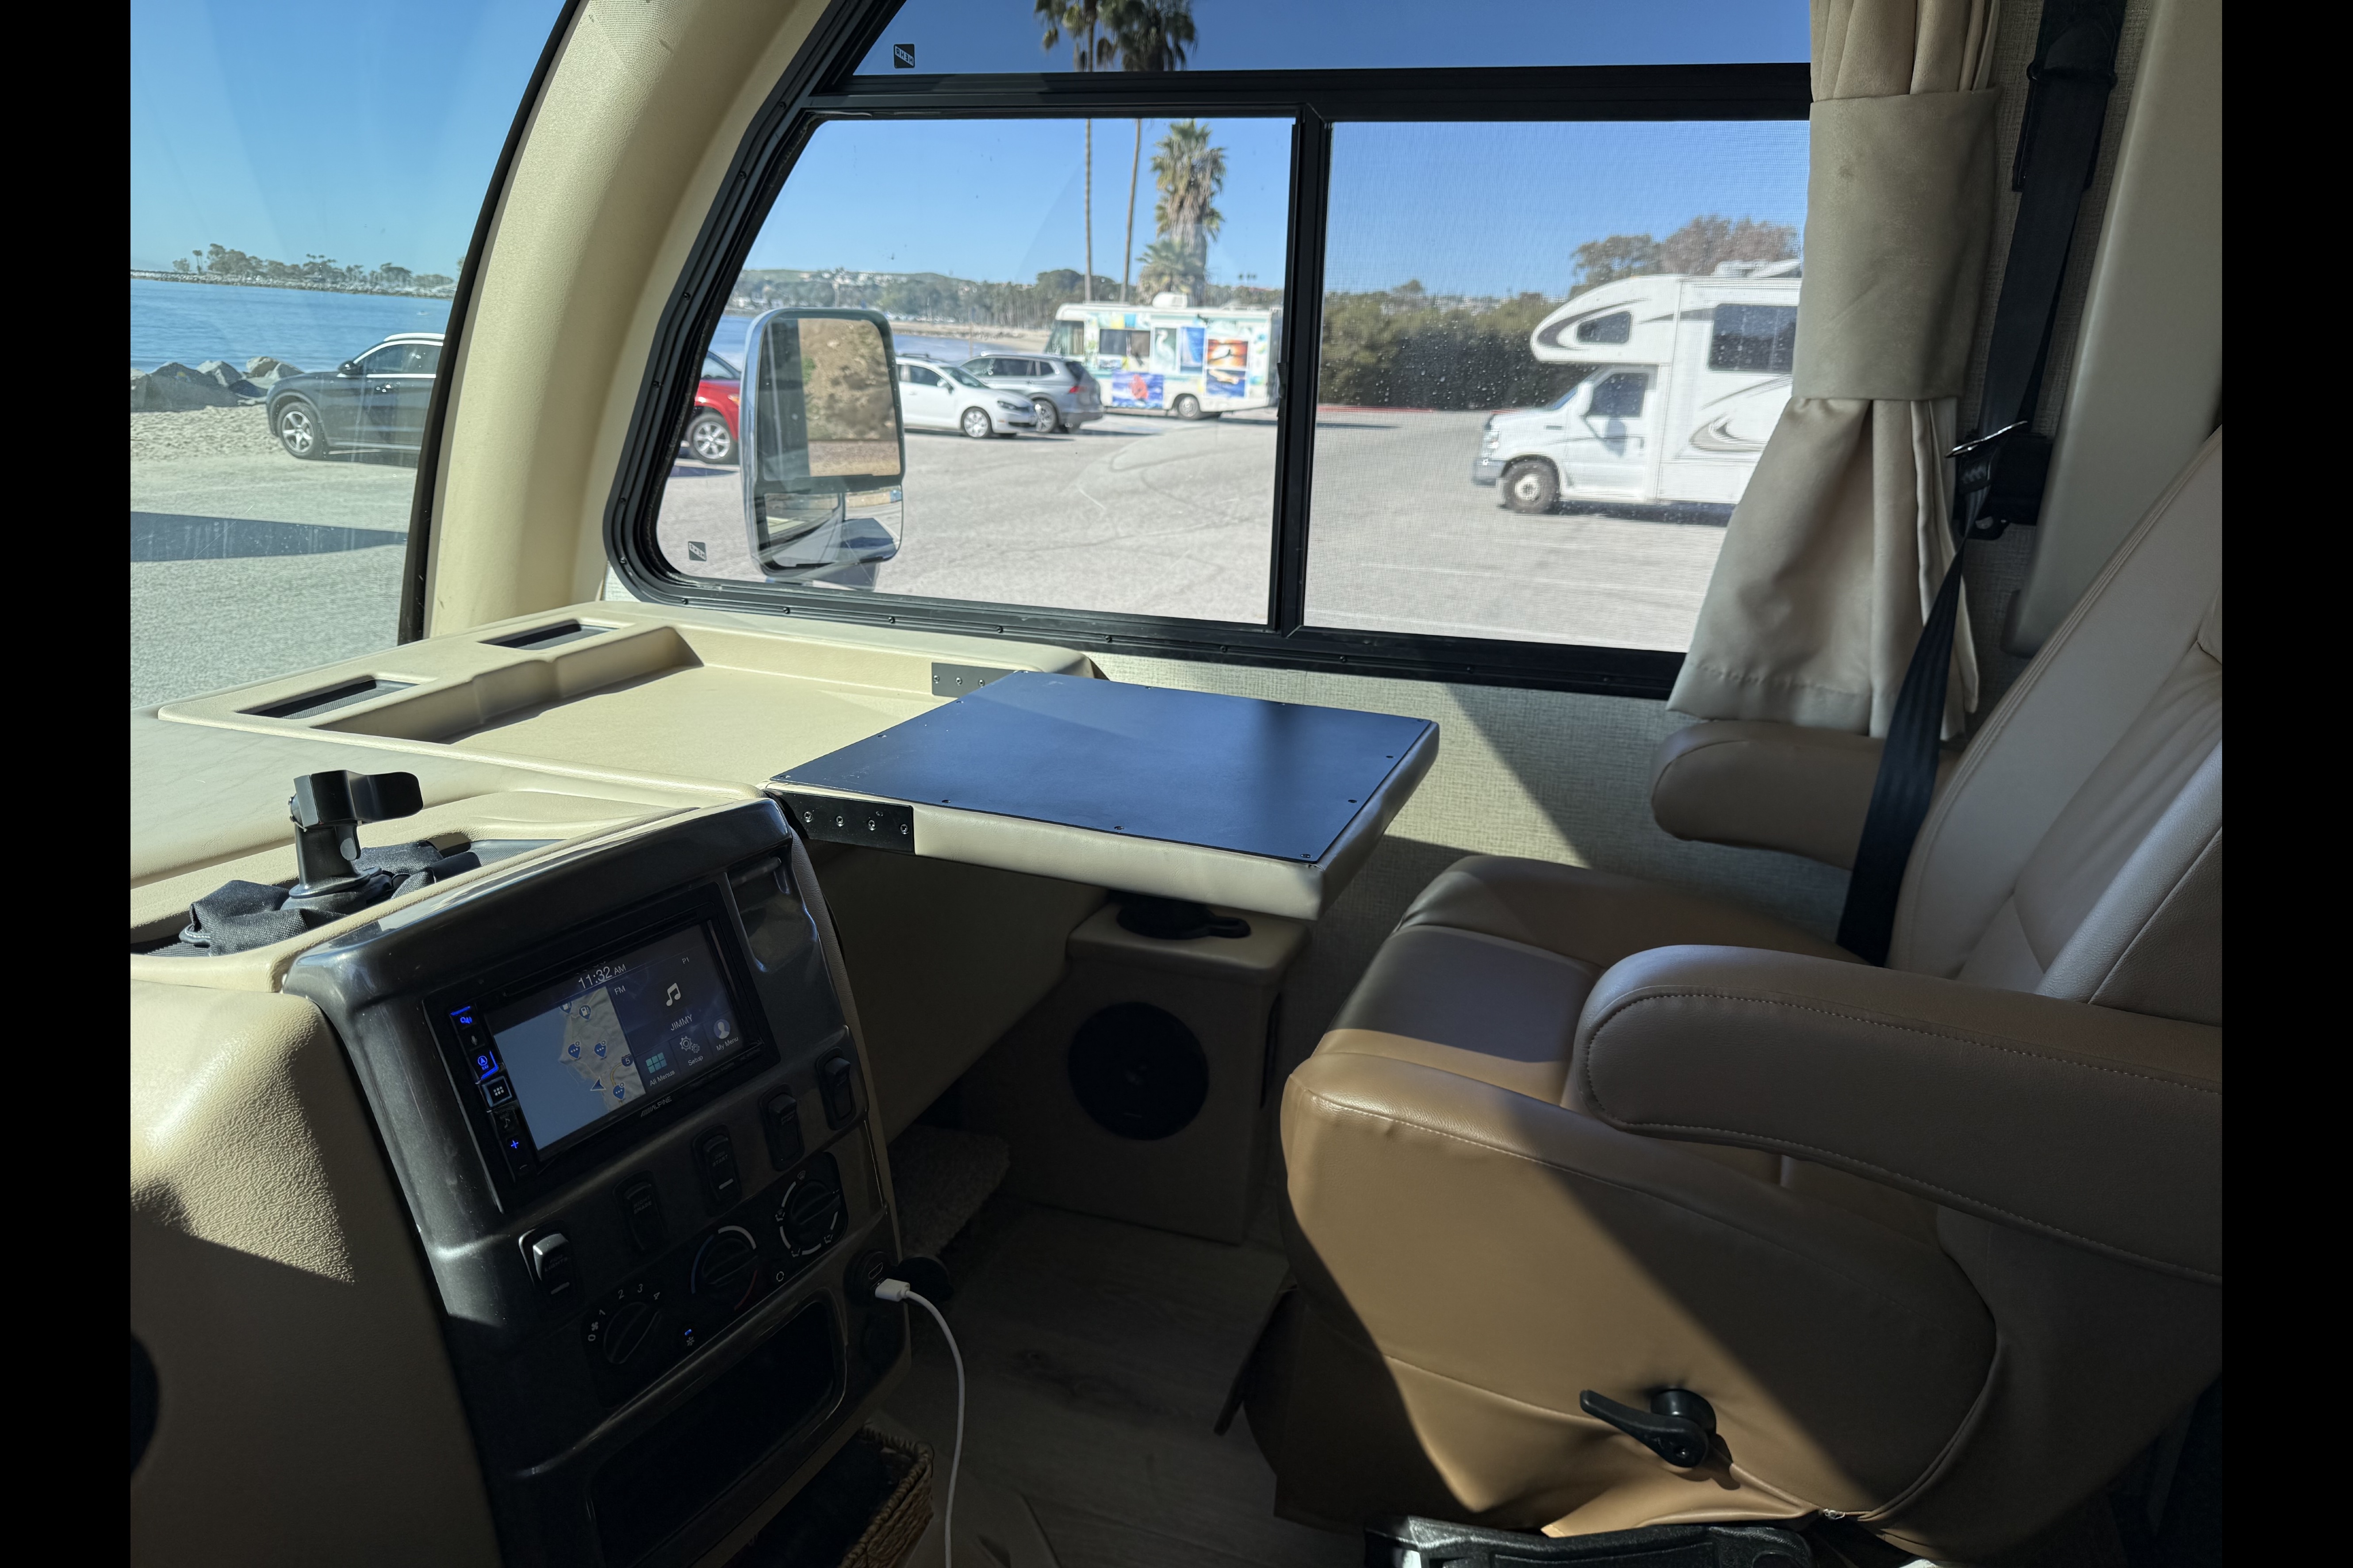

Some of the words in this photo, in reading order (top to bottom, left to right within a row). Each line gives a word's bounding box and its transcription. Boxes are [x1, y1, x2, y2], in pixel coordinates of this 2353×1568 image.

[579, 966, 612, 989] 11:32
[614, 964, 626, 975] AM
[614, 985, 626, 995] FM
[671, 1014, 692, 1031] JIMMY
[724, 1036, 739, 1047] Menu
[688, 1056, 703, 1066] Setup
[657, 1071, 675, 1082] Menus
[637, 1283, 643, 1293] 3
[618, 1289, 625, 1300] 2
[653, 1292, 660, 1300] 4
